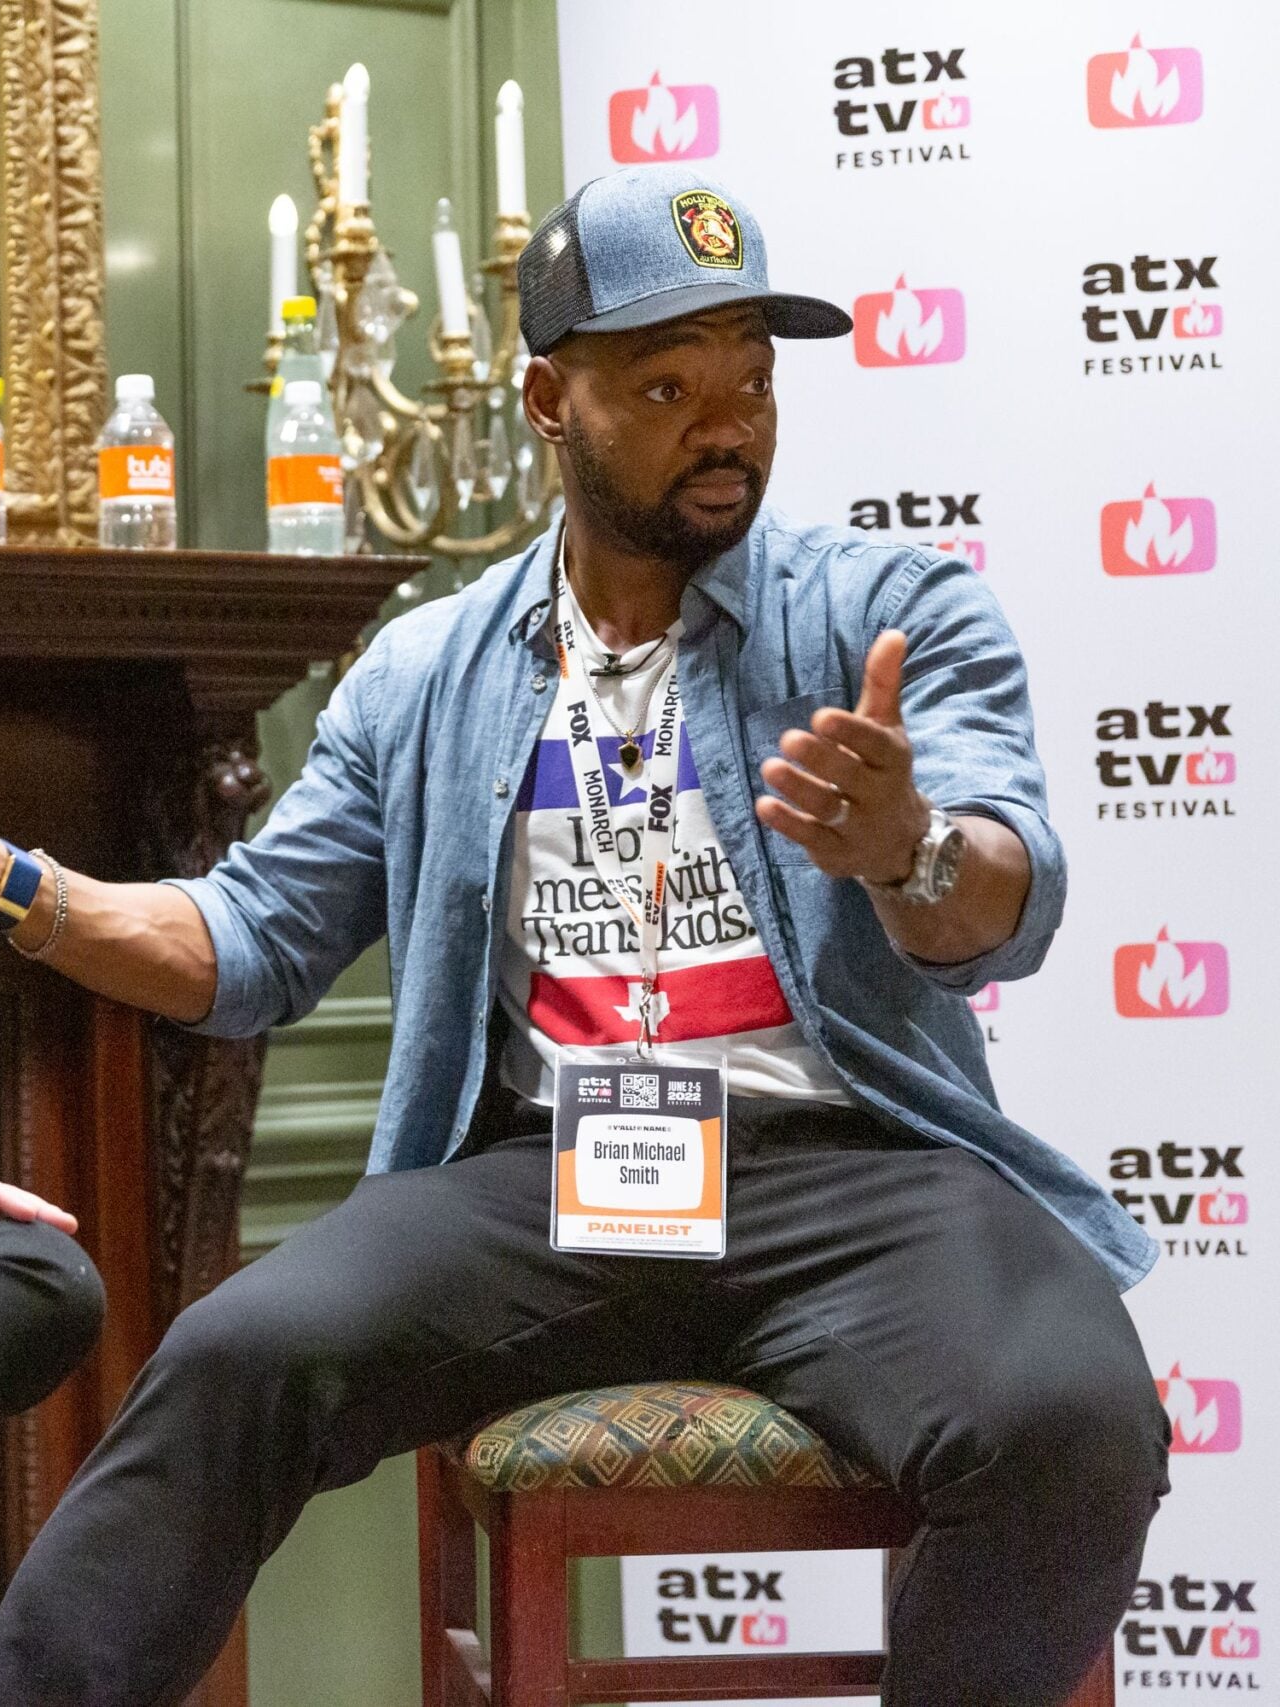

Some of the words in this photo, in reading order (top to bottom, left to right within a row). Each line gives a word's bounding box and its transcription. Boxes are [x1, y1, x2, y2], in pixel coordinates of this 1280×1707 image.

[834, 48, 966, 90] atx
[834, 99, 918, 136] tv
[836, 144, 970, 169] FESTIVAL
[1082, 255, 1220, 295] atx
[1082, 305, 1169, 343] tv
[1083, 352, 1223, 376] FESTIVAL
[127, 455, 170, 477] tubi
[850, 491, 981, 530] atx
[567, 700, 593, 748] FOX
[1096, 701, 1233, 741] atx
[1096, 750, 1182, 788] tv
[583, 769, 615, 853] MONARCH
[648, 783, 673, 833] FOX
[1098, 800, 1236, 820] FESTIVAL
[578, 1077, 611, 1087] atx
[667, 1081, 687, 1092] JUNE
[688, 1081, 701, 1092] 2-5
[667, 1092, 702, 1101] 2022
[593, 1140, 629, 1160] Brian
[633, 1141, 686, 1161] Michael
[1109, 1141, 1244, 1179] atx
[620, 1165, 659, 1184] Smith
[587, 1222, 692, 1236] PANELIST
[1165, 1240, 1248, 1256] TIVAL
[657, 1565, 784, 1601] atx
[1128, 1574, 1257, 1613] atx
[657, 1607, 738, 1643] tv
[1122, 1619, 1207, 1657] tv
[1123, 1670, 1260, 1690] FESTIVAL
